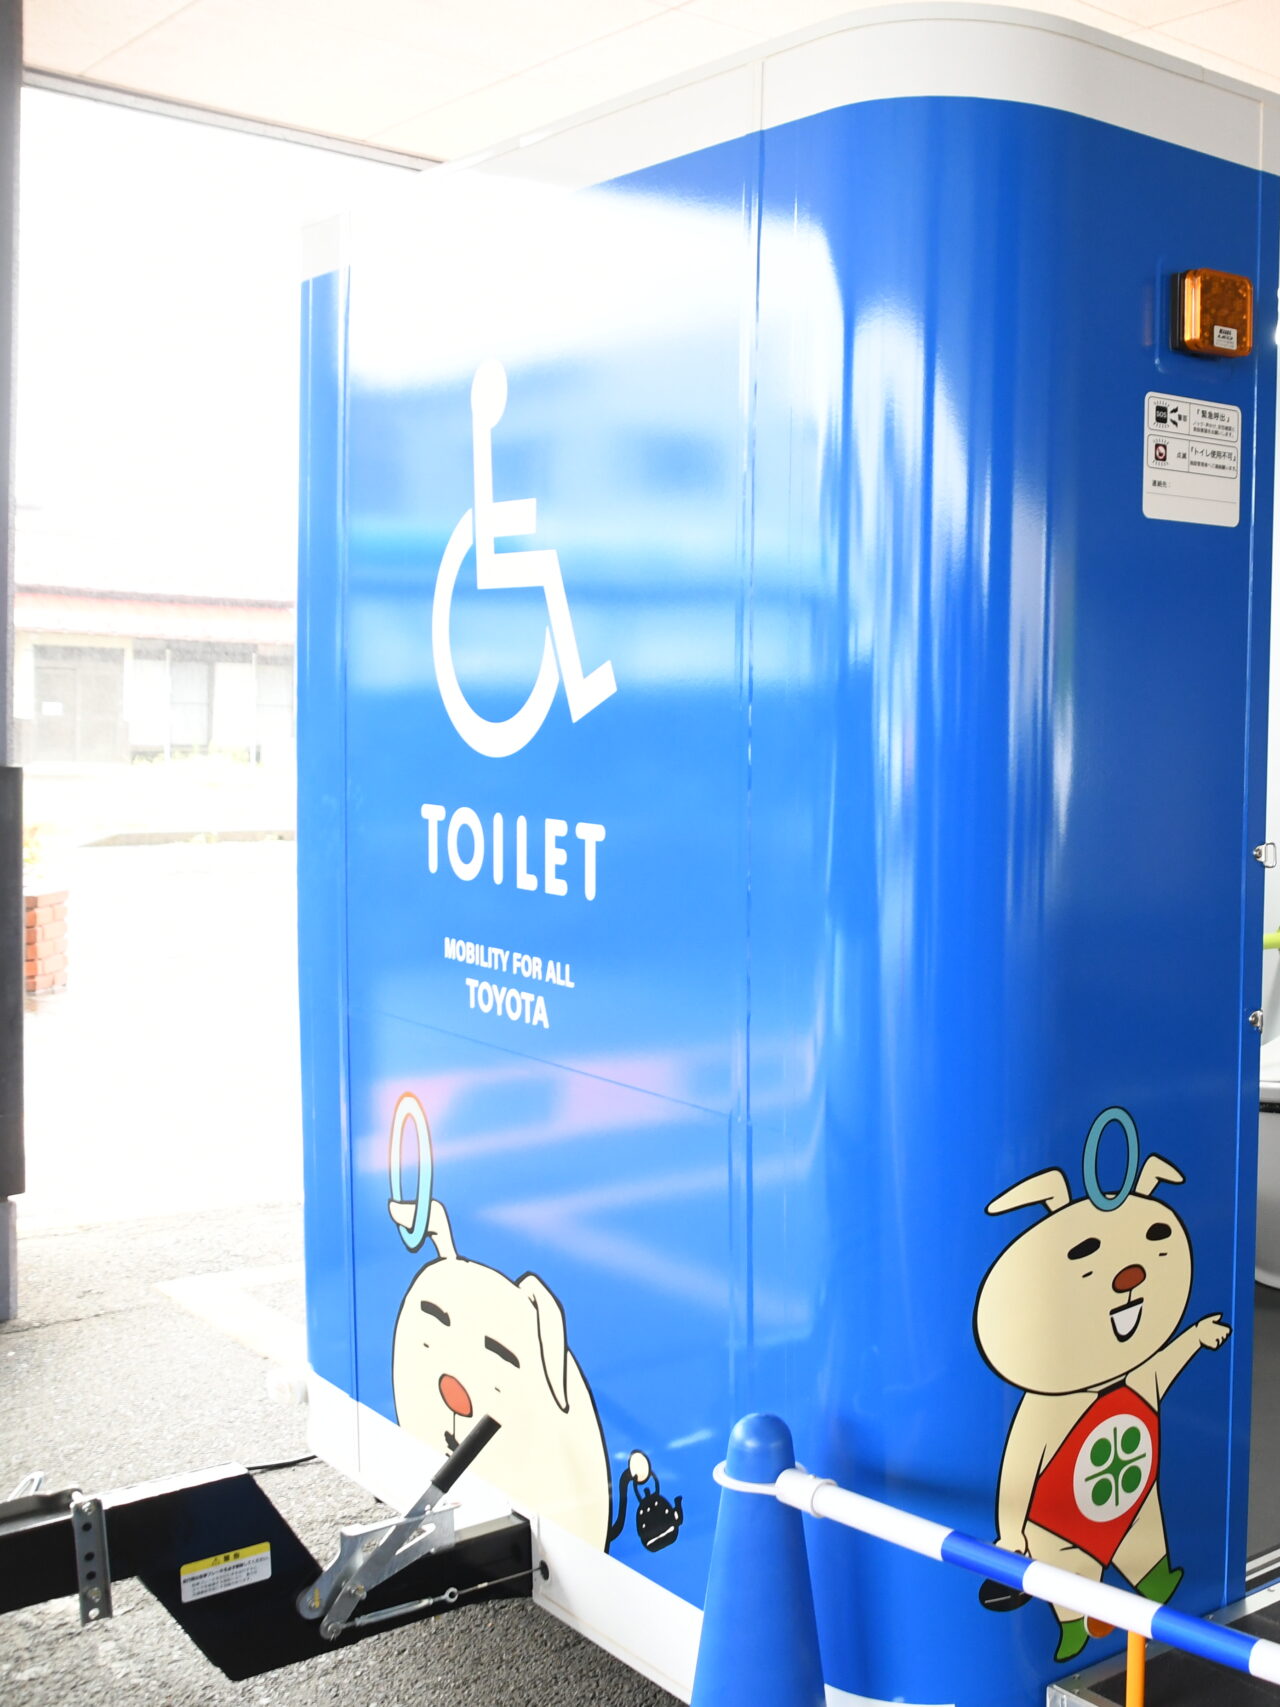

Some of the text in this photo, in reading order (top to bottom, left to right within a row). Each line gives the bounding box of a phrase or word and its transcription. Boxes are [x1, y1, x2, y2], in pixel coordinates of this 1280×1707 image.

[421, 803, 606, 901] TOILET
[444, 937, 575, 989] MOBILITY FOR ALL
[465, 977, 550, 1029] TOYOTA
